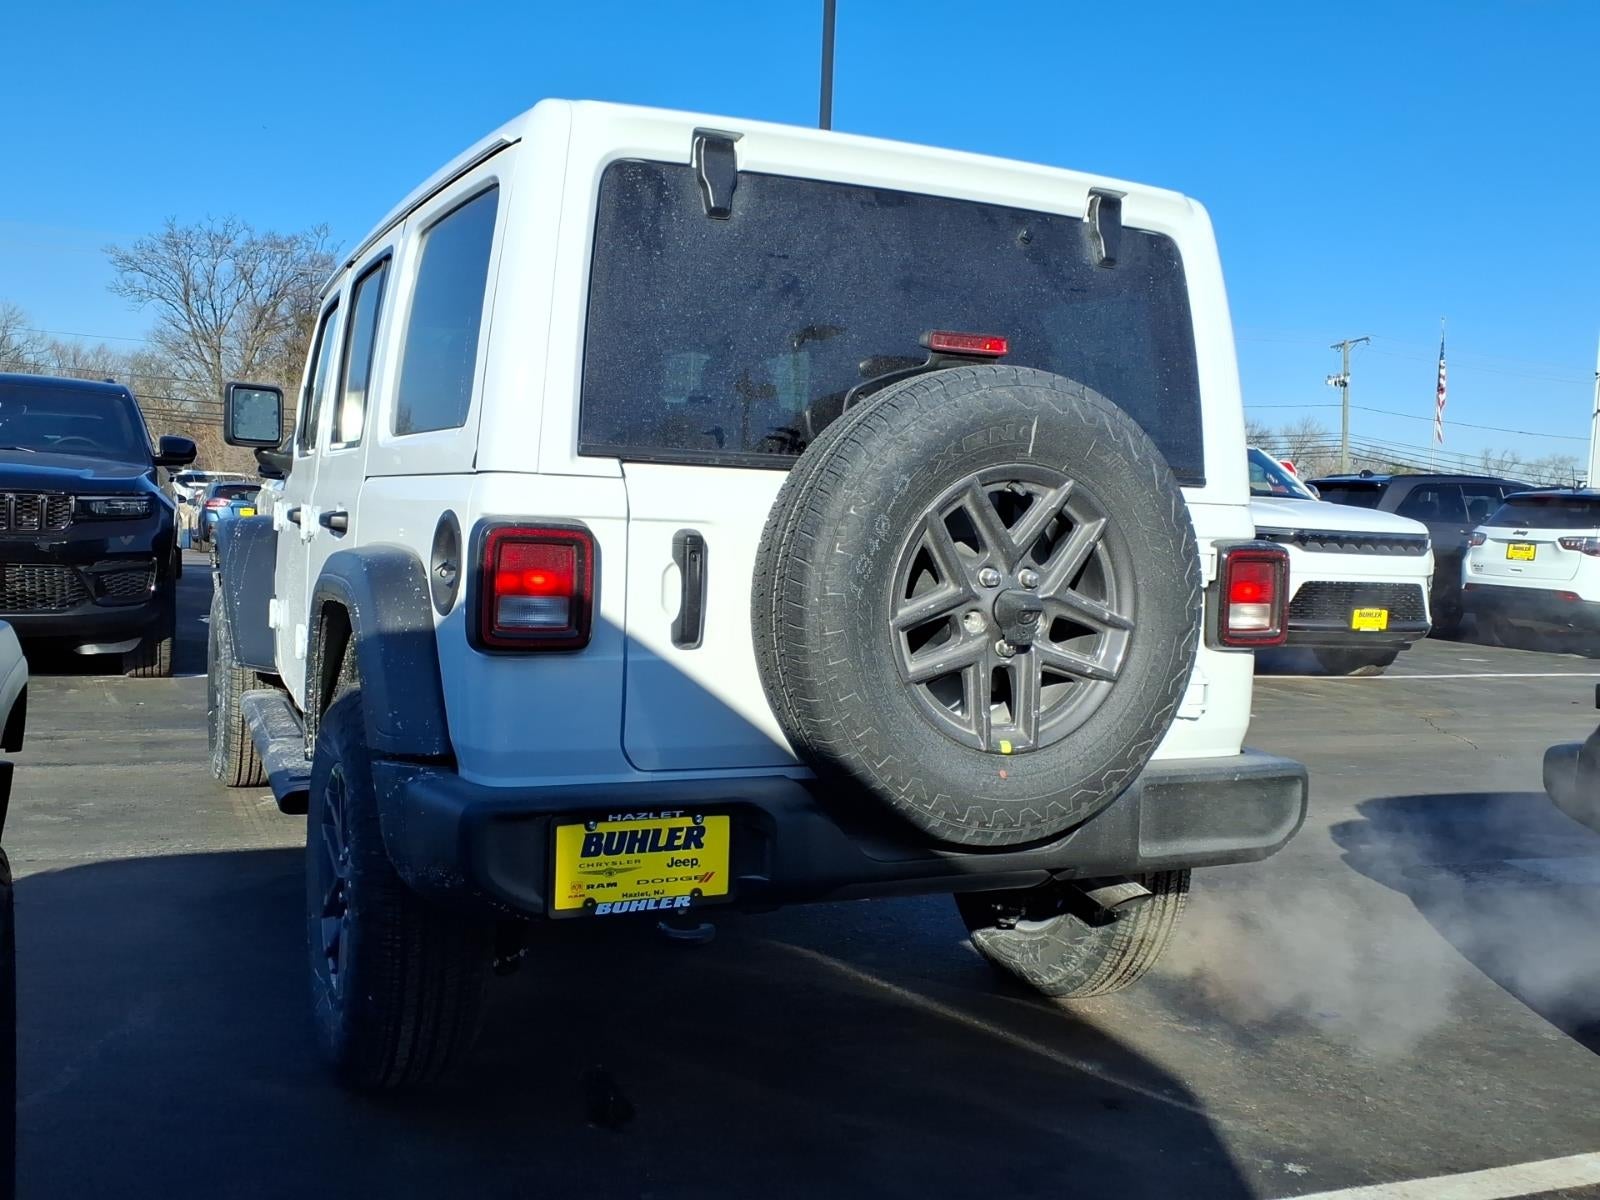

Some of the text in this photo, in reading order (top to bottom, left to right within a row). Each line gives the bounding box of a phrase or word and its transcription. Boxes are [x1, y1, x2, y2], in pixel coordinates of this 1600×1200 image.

[608, 810, 684, 822] HAZLET
[580, 826, 706, 858] BUHLER
[578, 859, 642, 869] CHRYSLER
[666, 856, 699, 869] Jeep
[586, 881, 618, 891] RAM
[636, 874, 705, 886] DODGE
[621, 890, 651, 899] Hazlet,
[595, 895, 691, 915] BUHLER
